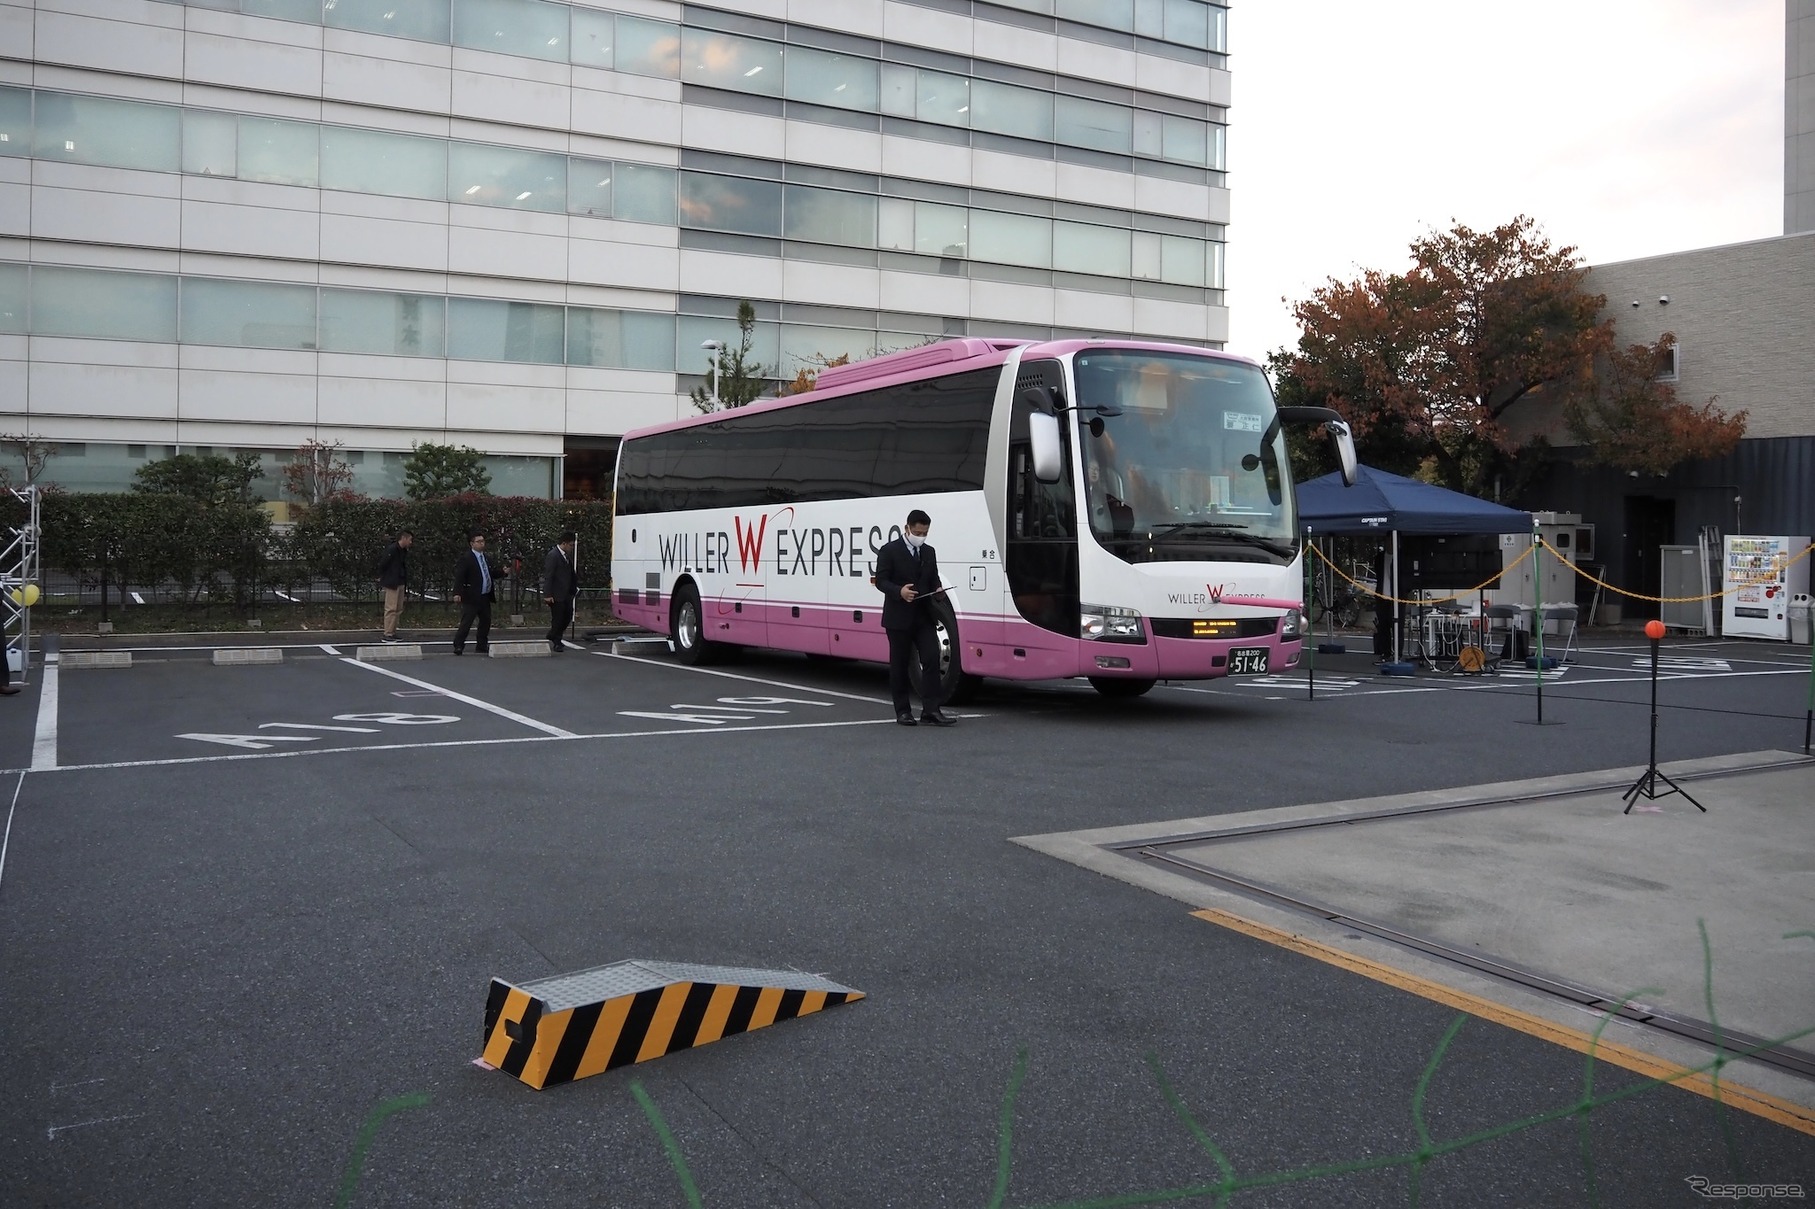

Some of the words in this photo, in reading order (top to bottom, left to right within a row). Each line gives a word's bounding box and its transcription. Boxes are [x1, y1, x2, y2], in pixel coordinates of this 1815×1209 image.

[659, 531, 730, 574] WILLER
[734, 514, 768, 577] W
[1168, 593, 1205, 604] WILLER
[615, 696, 835, 724] A19
[173, 712, 462, 749] A18
